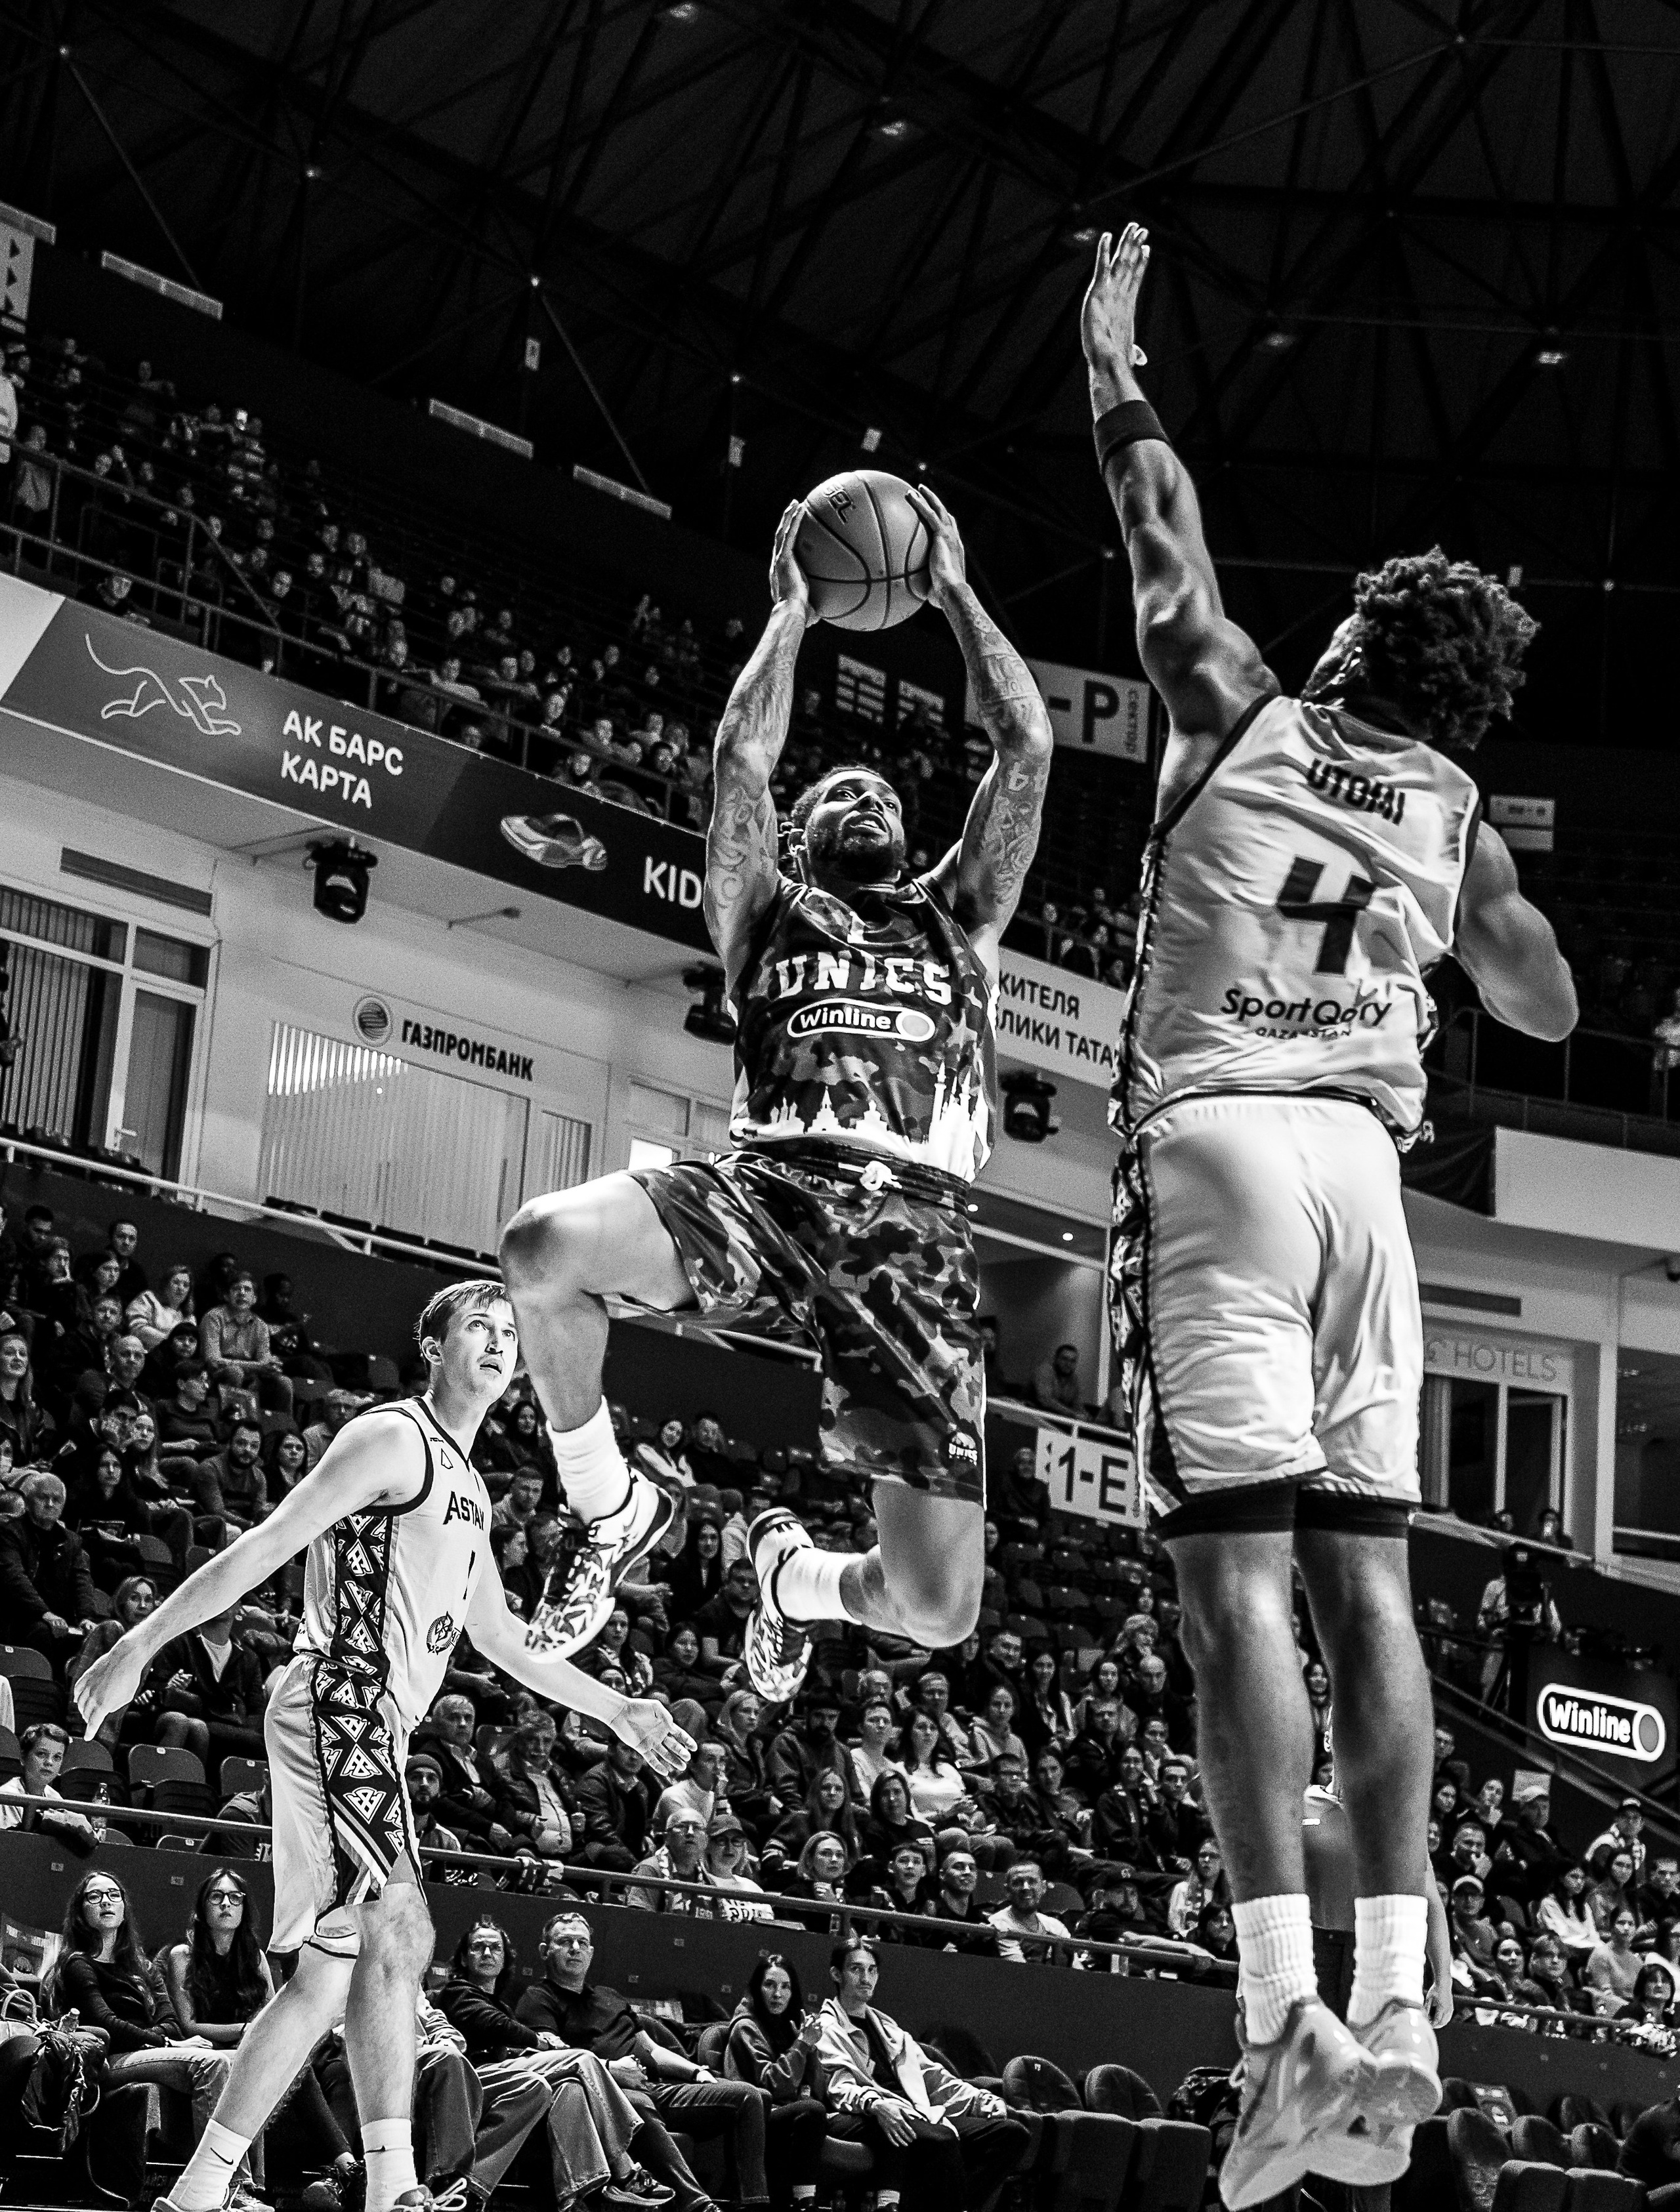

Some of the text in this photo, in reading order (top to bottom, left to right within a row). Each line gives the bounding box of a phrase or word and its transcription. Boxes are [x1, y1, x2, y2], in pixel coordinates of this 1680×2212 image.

[282, 709, 405, 776] АК БАРС
[281, 751, 373, 810] КАРТА
[1307, 758, 1406, 825] UTOMI
[1276, 854, 1378, 975] 4
[776, 949, 952, 1006] UNICS
[800, 1006, 891, 1030] Winline
[401, 1019, 535, 1081] ГАЗПРОМБАНК
[1065, 1030, 1120, 1070] ТАТА
[1454, 1342, 1557, 1383] HOTELS
[1548, 1697, 1631, 1743] Winline
